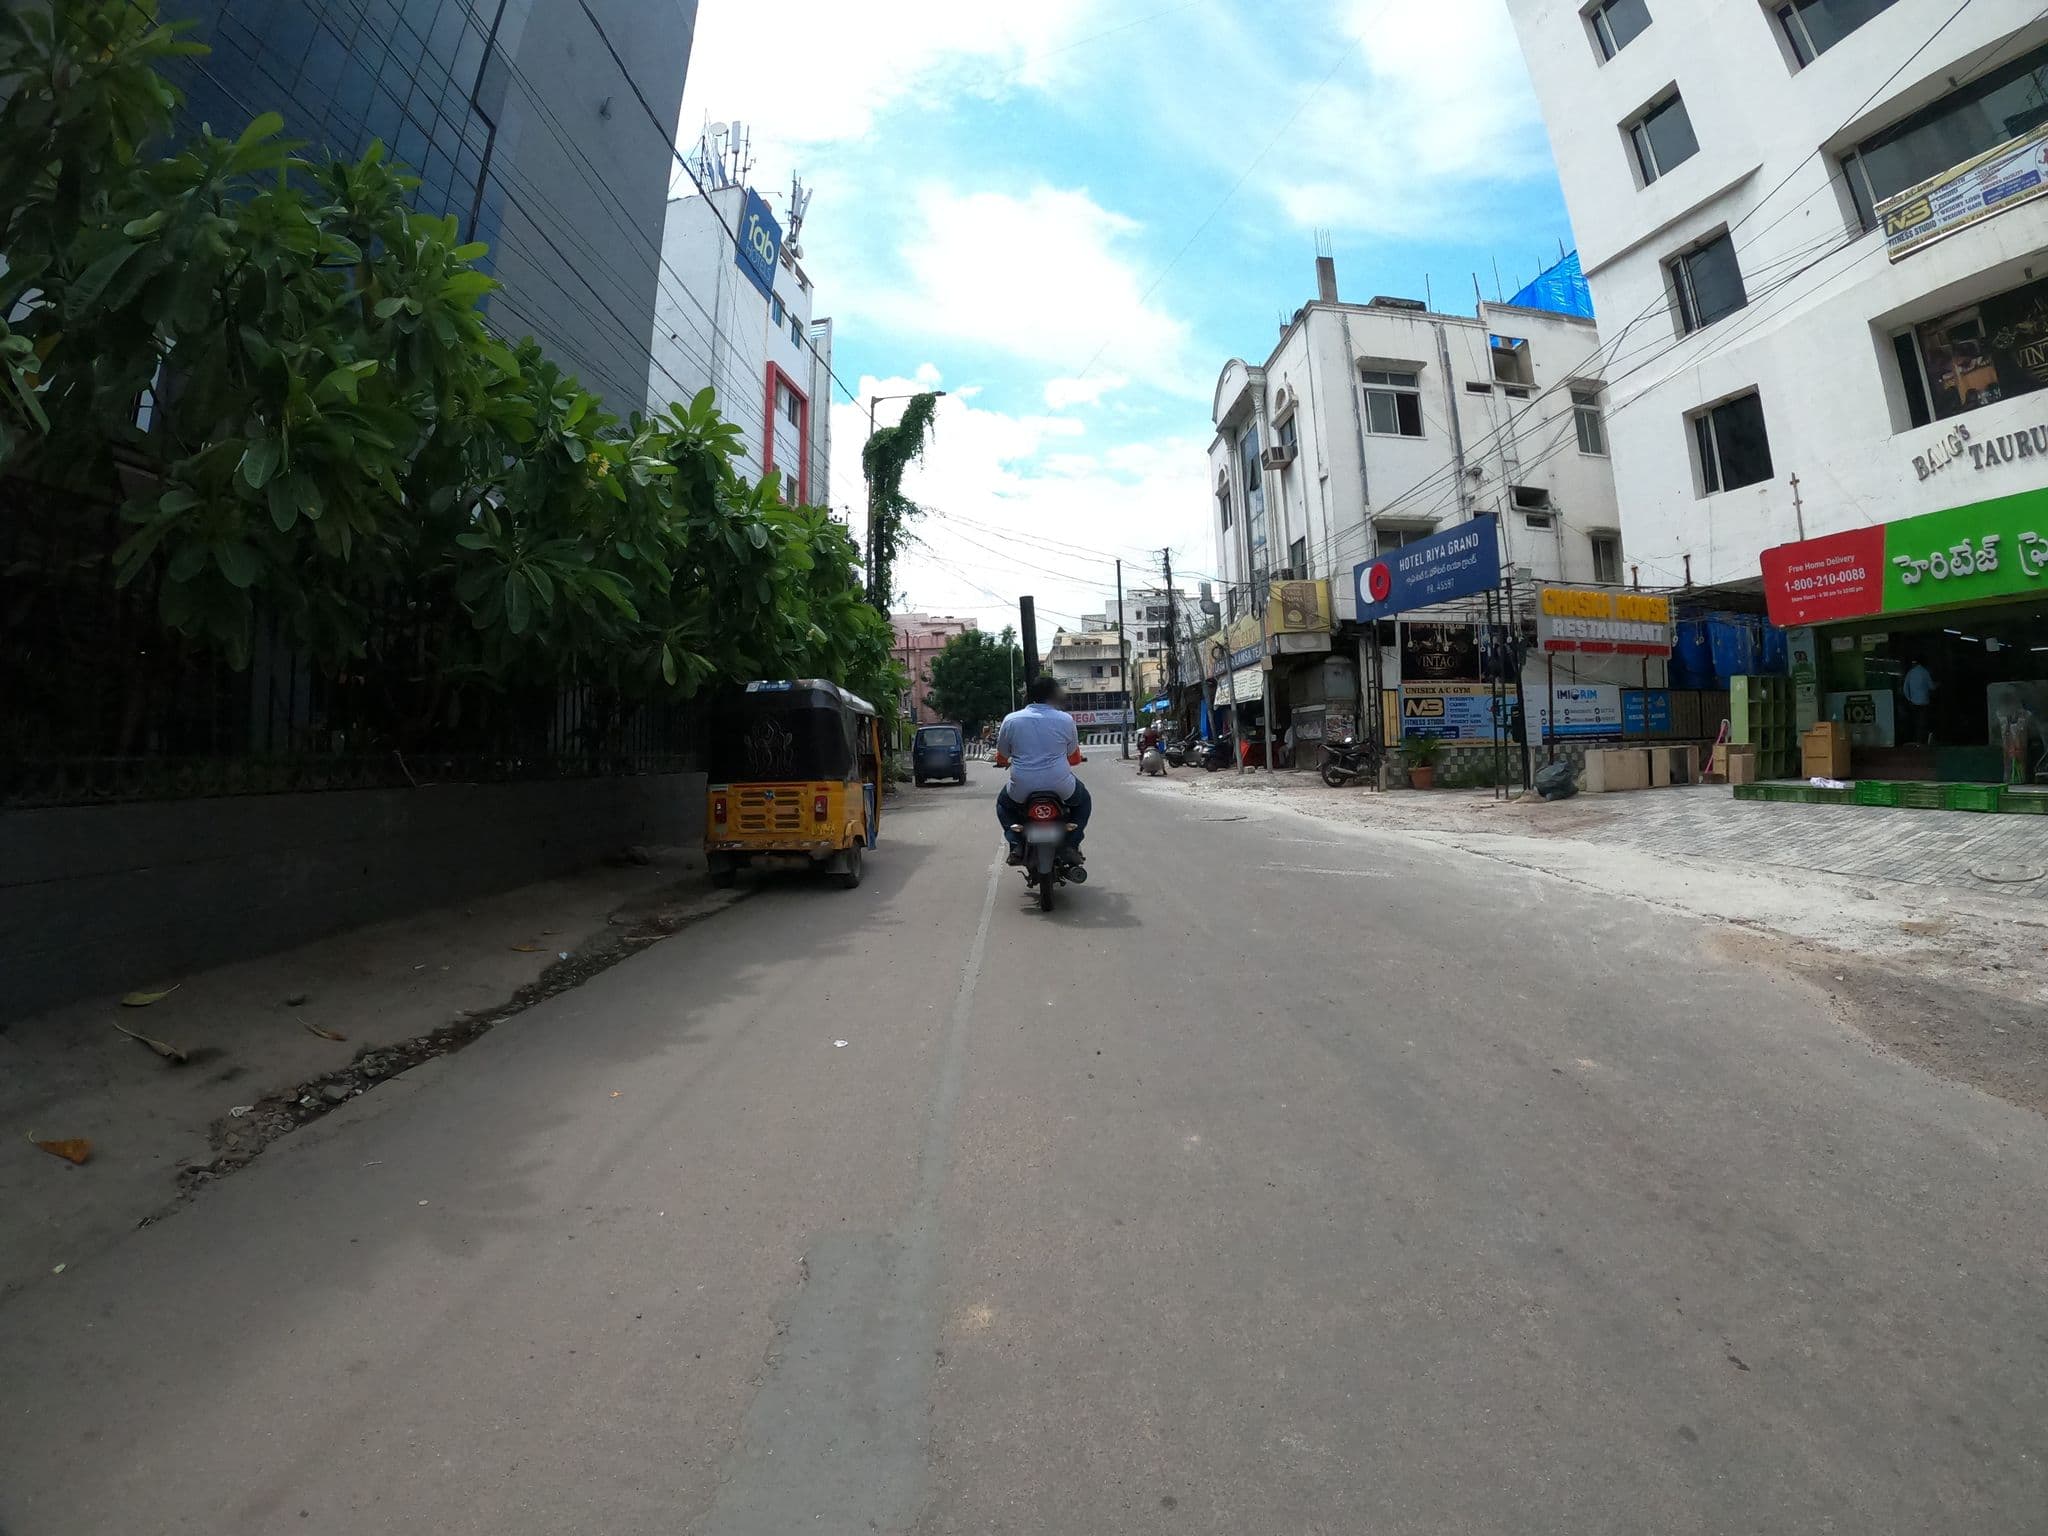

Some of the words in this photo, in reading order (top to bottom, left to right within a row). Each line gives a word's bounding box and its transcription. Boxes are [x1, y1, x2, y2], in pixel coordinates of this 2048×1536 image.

[1940, 200, 1963, 215] WEIGHT
[1942, 208, 1966, 223] WEIGHT
[1914, 220, 1937, 234] STUDIO
[1968, 424, 2048, 470] TAURU
[1399, 552, 1424, 572] HOTEL
[1426, 545, 1446, 563] RIYA
[1448, 532, 1480, 555] GRAND
[1788, 564, 1804, 574] Free
[1805, 561, 1825, 570] Home
[1826, 554, 1855, 567] Delivery
[1784, 567, 1866, 592] 1-800-210-0088
[1615, 594, 1670, 624] HOUSE
[1552, 618, 1664, 642] RESTAURANT
[1405, 687, 1437, 695] UNISEX
